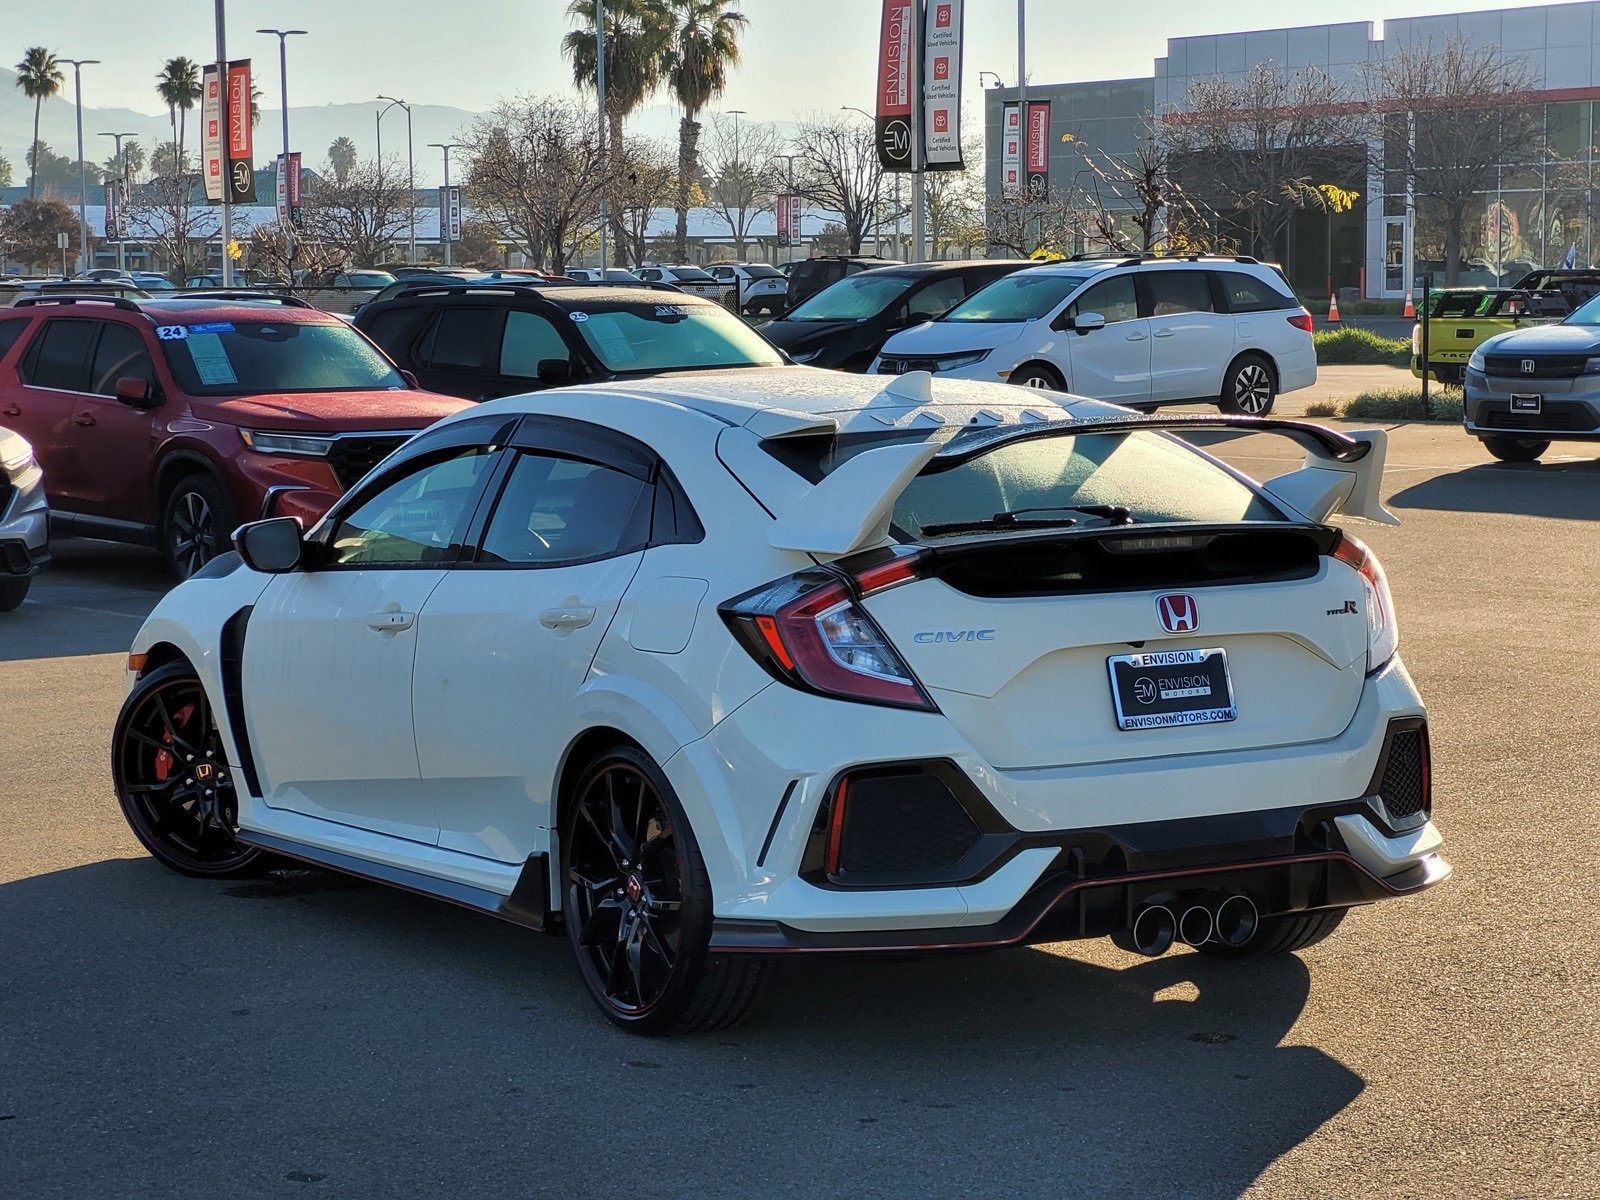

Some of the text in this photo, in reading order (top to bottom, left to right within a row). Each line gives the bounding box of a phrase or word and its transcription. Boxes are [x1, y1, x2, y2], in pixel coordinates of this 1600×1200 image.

[932, 31, 952, 39] Certified
[886, 7, 902, 106] ENVISION
[901, 15, 909, 97] MOTORS
[232, 74, 241, 152] ENVISION
[932, 136, 951, 144] Certified
[1031, 110, 1040, 167] ENVISION
[571, 312, 587, 321] 25
[163, 327, 182, 337] 24
[914, 629, 995, 643] CIVIC
[1142, 651, 1195, 666] ENVISION
[1158, 674, 1211, 690] ENVISION
[1164, 688, 1208, 697] MOTORS
[1124, 709, 1233, 728] ENVISIONMOTORS.COM
